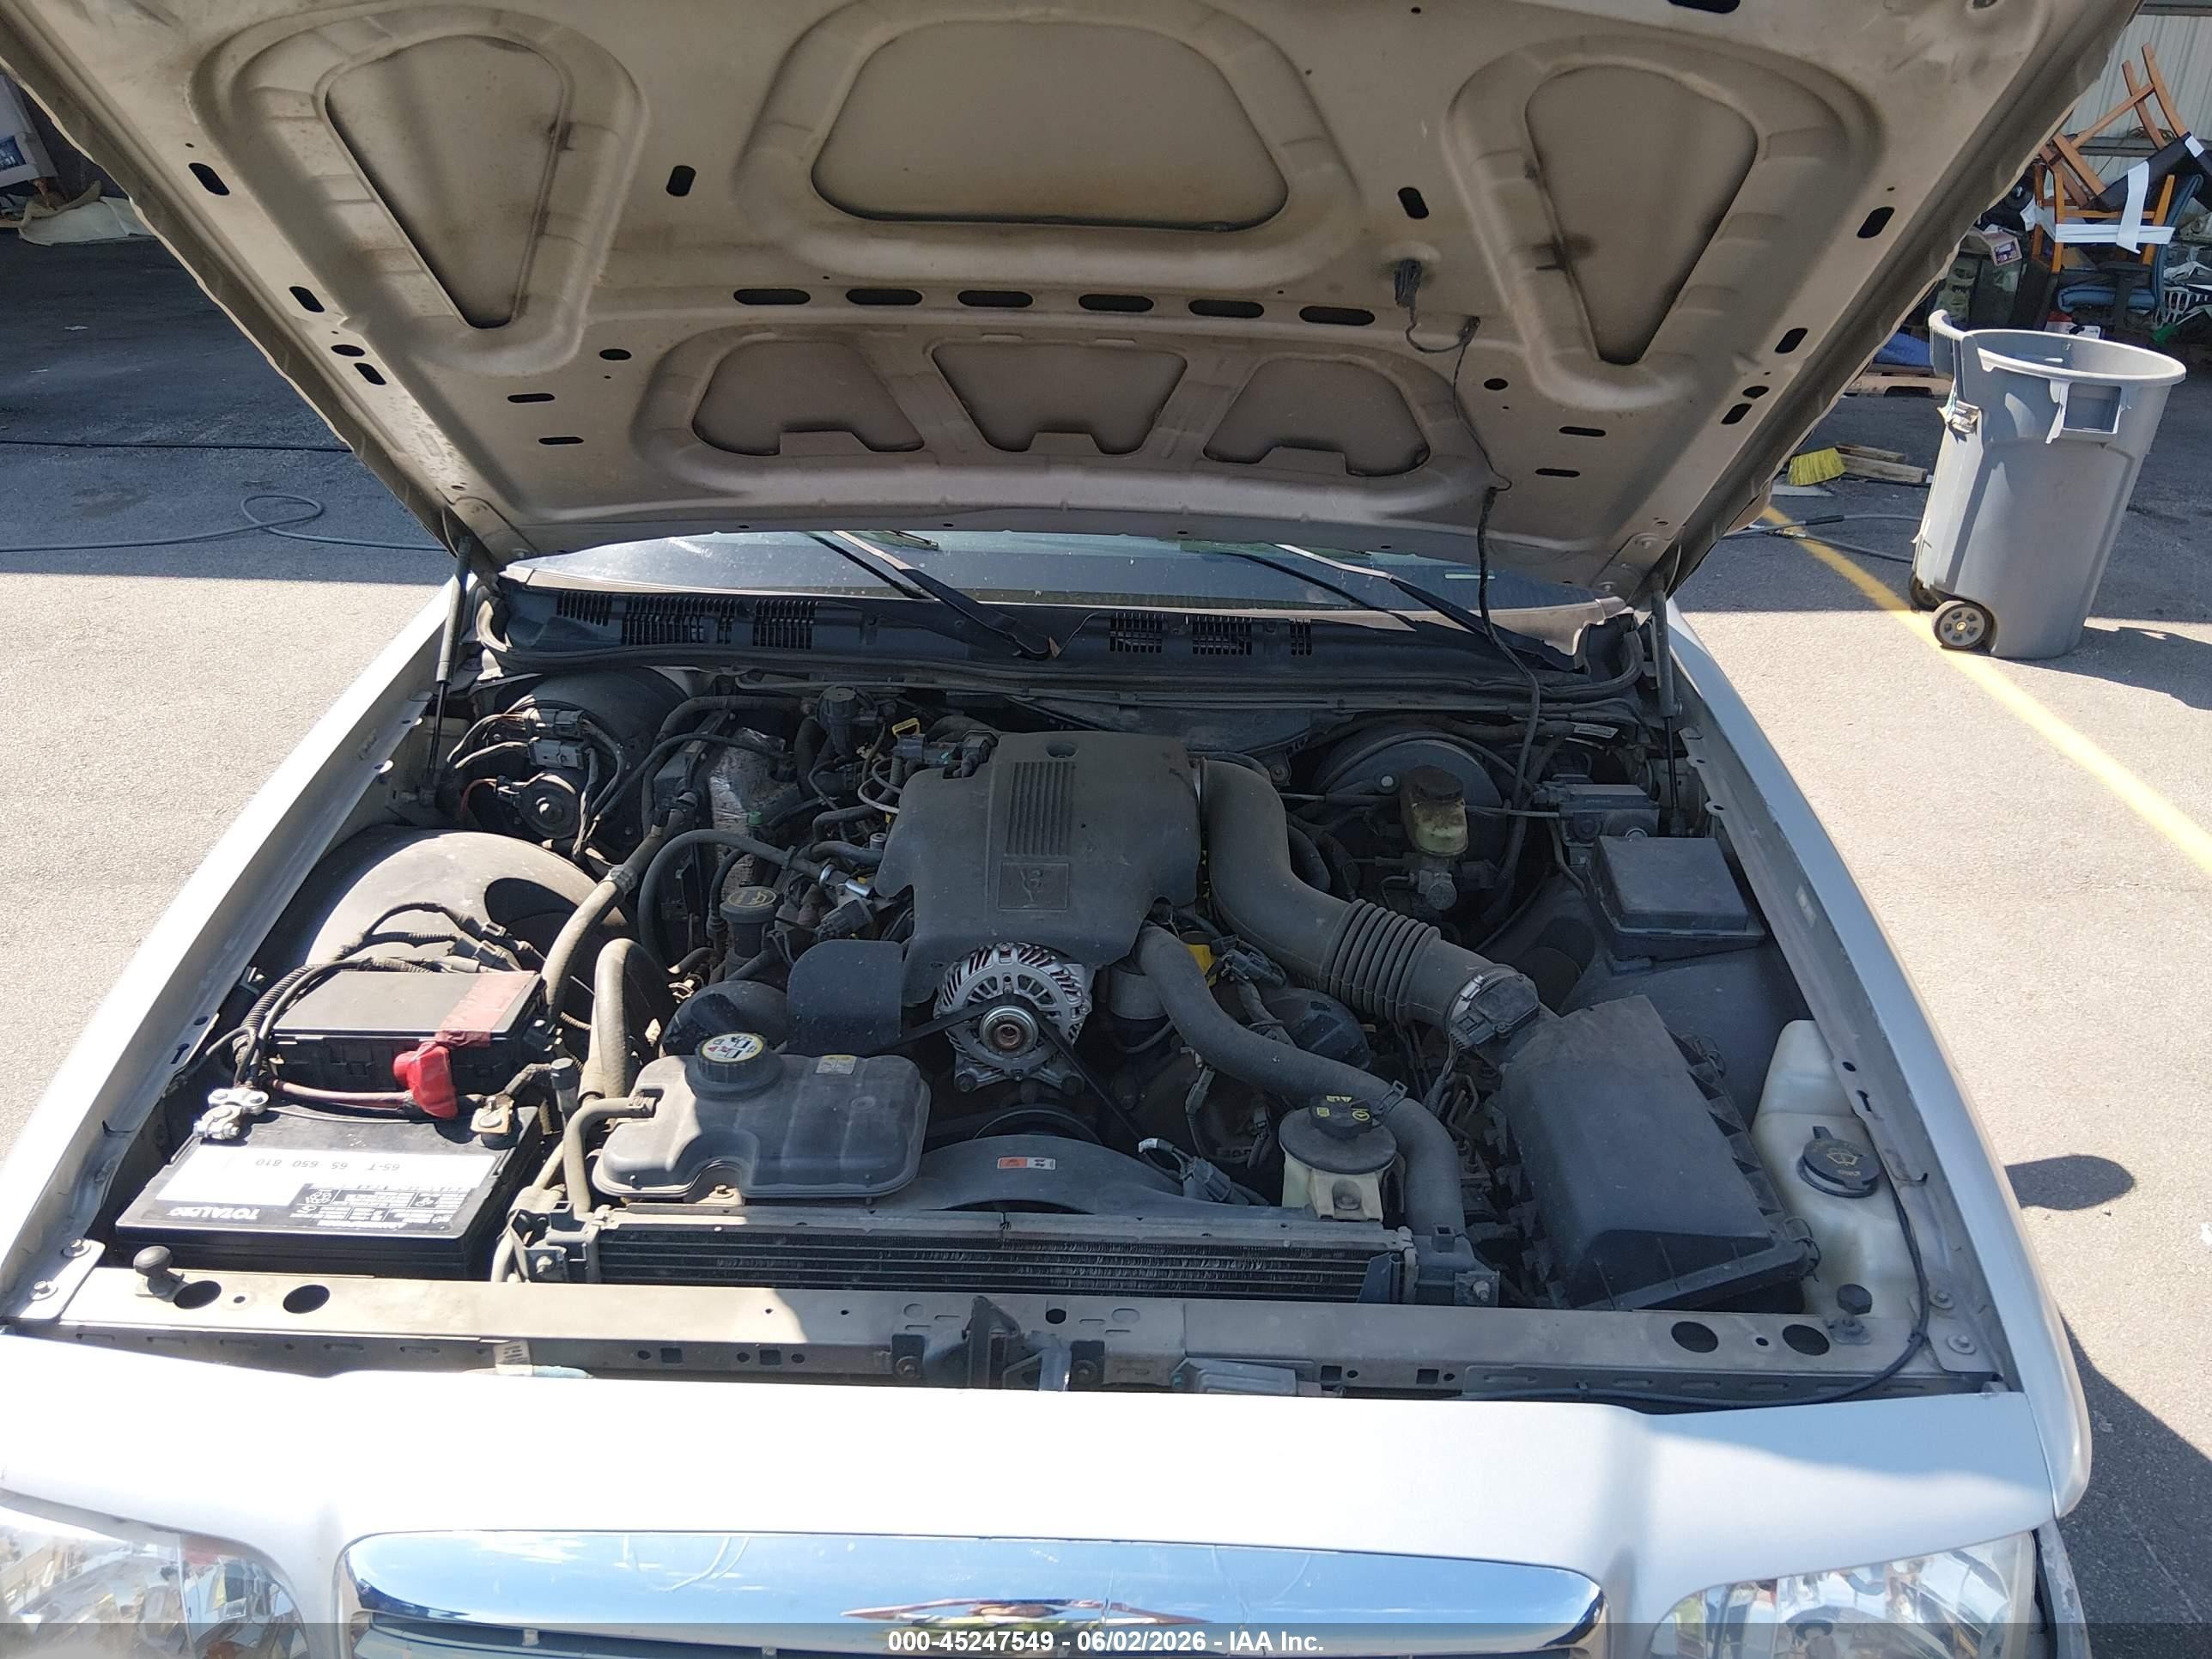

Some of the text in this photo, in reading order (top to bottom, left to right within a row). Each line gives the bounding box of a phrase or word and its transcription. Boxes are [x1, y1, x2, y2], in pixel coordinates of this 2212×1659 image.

[255, 1158, 400, 1172] 65-T 65 650 810
